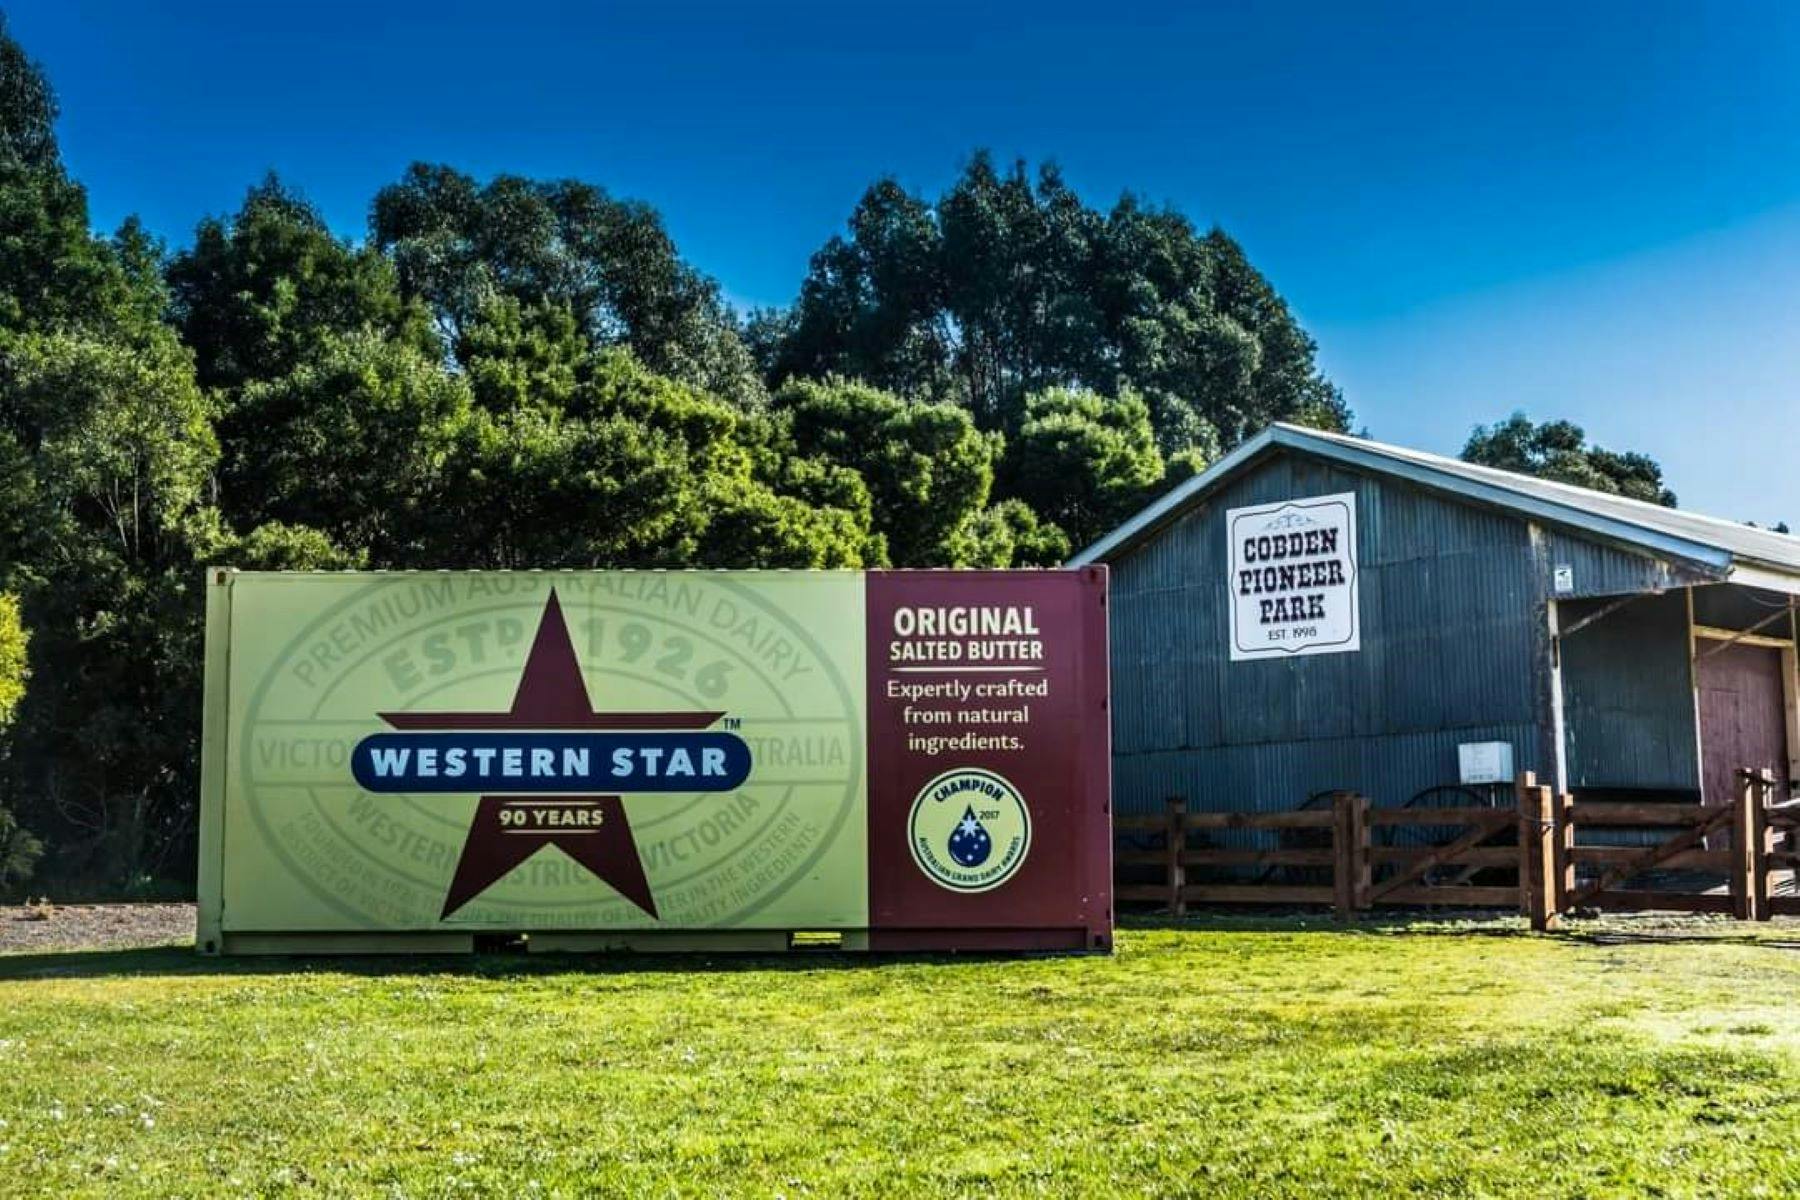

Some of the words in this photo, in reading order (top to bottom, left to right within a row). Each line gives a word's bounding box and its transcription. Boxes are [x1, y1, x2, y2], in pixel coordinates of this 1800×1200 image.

[1243, 527, 1339, 563] COBDEN
[1239, 559, 1345, 595] PIONEER
[893, 606, 1041, 637] ORIGINAL
[1259, 593, 1326, 625] PARK
[292, 579, 457, 688] PREMIUM
[466, 573, 705, 619] AUSTRALIAN
[709, 599, 813, 681] DAIRY
[579, 616, 736, 699] 1926
[889, 640, 962, 661] SALTED
[967, 640, 1043, 660] BUTTER
[887, 679, 972, 702] Expertly
[975, 679, 1048, 697] crafted
[903, 706, 952, 724] from
[957, 705, 1029, 724] natural
[256, 738, 347, 770] VICTO
[748, 736, 846, 768] TRALIA
[908, 732, 1025, 756] ingredients.
[370, 747, 590, 777] WESTERN
[610, 747, 728, 777] STAR
[933, 778, 1005, 803] CHAMPION
[348, 793, 462, 872] WESTERN
[641, 790, 761, 873] VICTORIA
[499, 810, 527, 826] 90
[531, 810, 604, 826] YEARS
[737, 810, 801, 874] WESTERN
